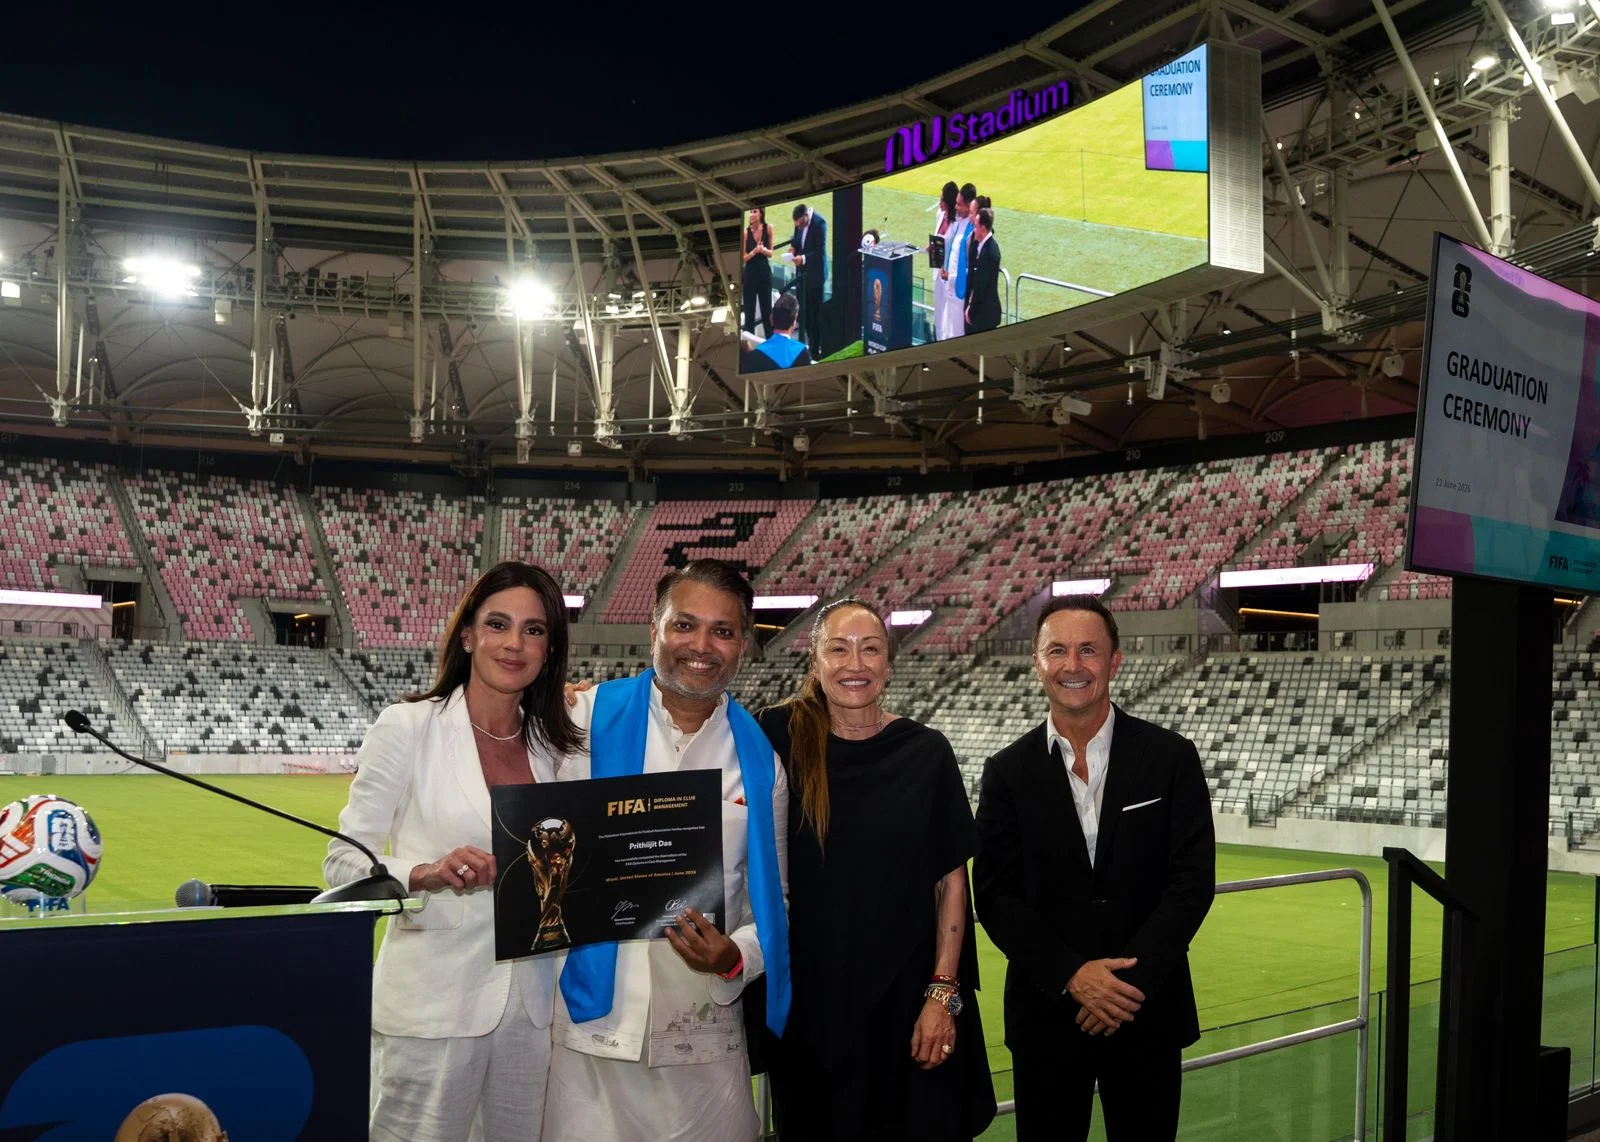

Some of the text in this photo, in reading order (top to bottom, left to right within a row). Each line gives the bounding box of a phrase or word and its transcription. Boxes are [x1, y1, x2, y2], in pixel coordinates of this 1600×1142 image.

[1150, 82, 1193, 97] CEREMONY
[949, 79, 1070, 149] Stadium
[1446, 351, 1548, 405] GRADUATION
[1443, 393, 1531, 439] CEREMONY
[1264, 430, 1285, 444] 209
[1549, 555, 1569, 572] FIFA
[607, 798, 646, 817] FIFA
[653, 802, 688, 810] MANAGEMENT
[658, 840, 673, 848] Das
